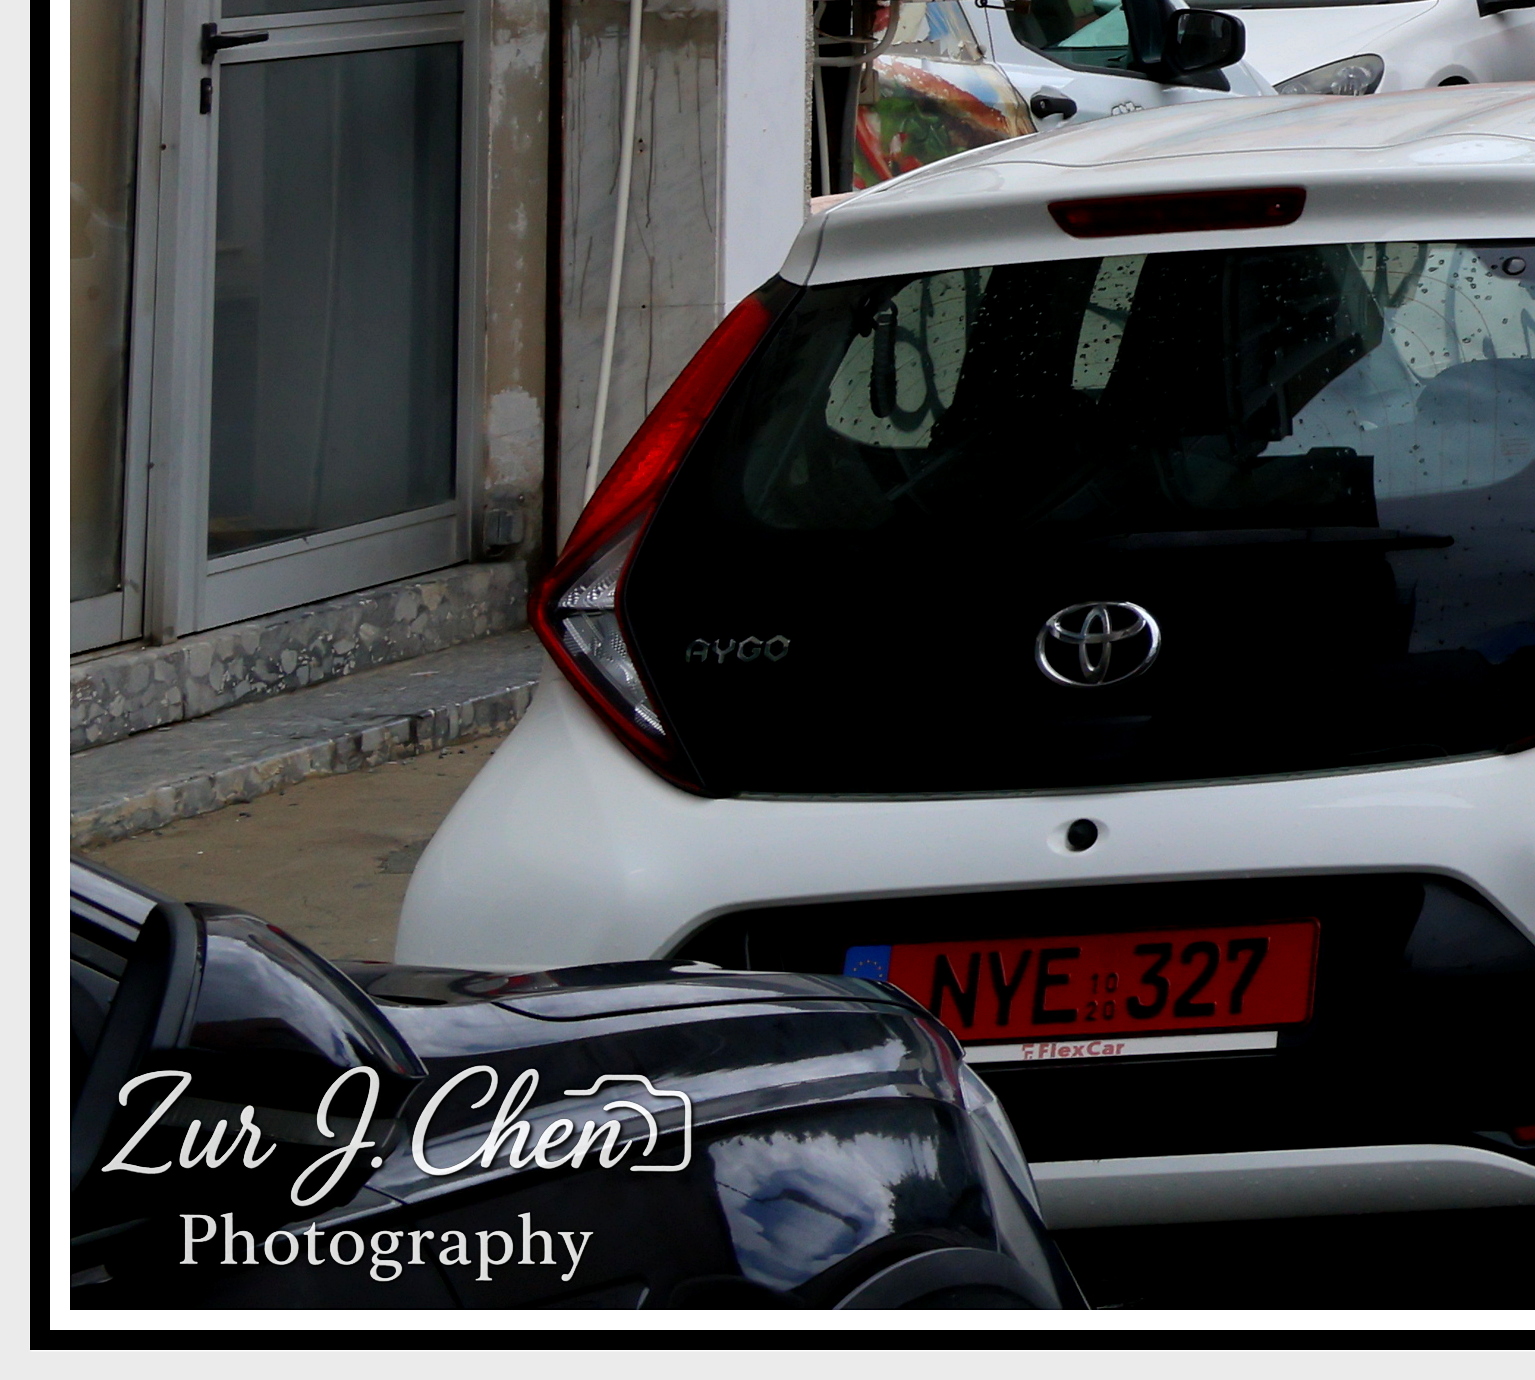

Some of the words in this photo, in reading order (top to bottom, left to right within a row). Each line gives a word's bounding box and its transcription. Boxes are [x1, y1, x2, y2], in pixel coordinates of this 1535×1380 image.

[685, 634, 791, 664] AYGO
[928, 945, 1083, 1028] NYE
[1126, 937, 1270, 1020] 327
[1038, 1041, 1125, 1058] FlexCar
